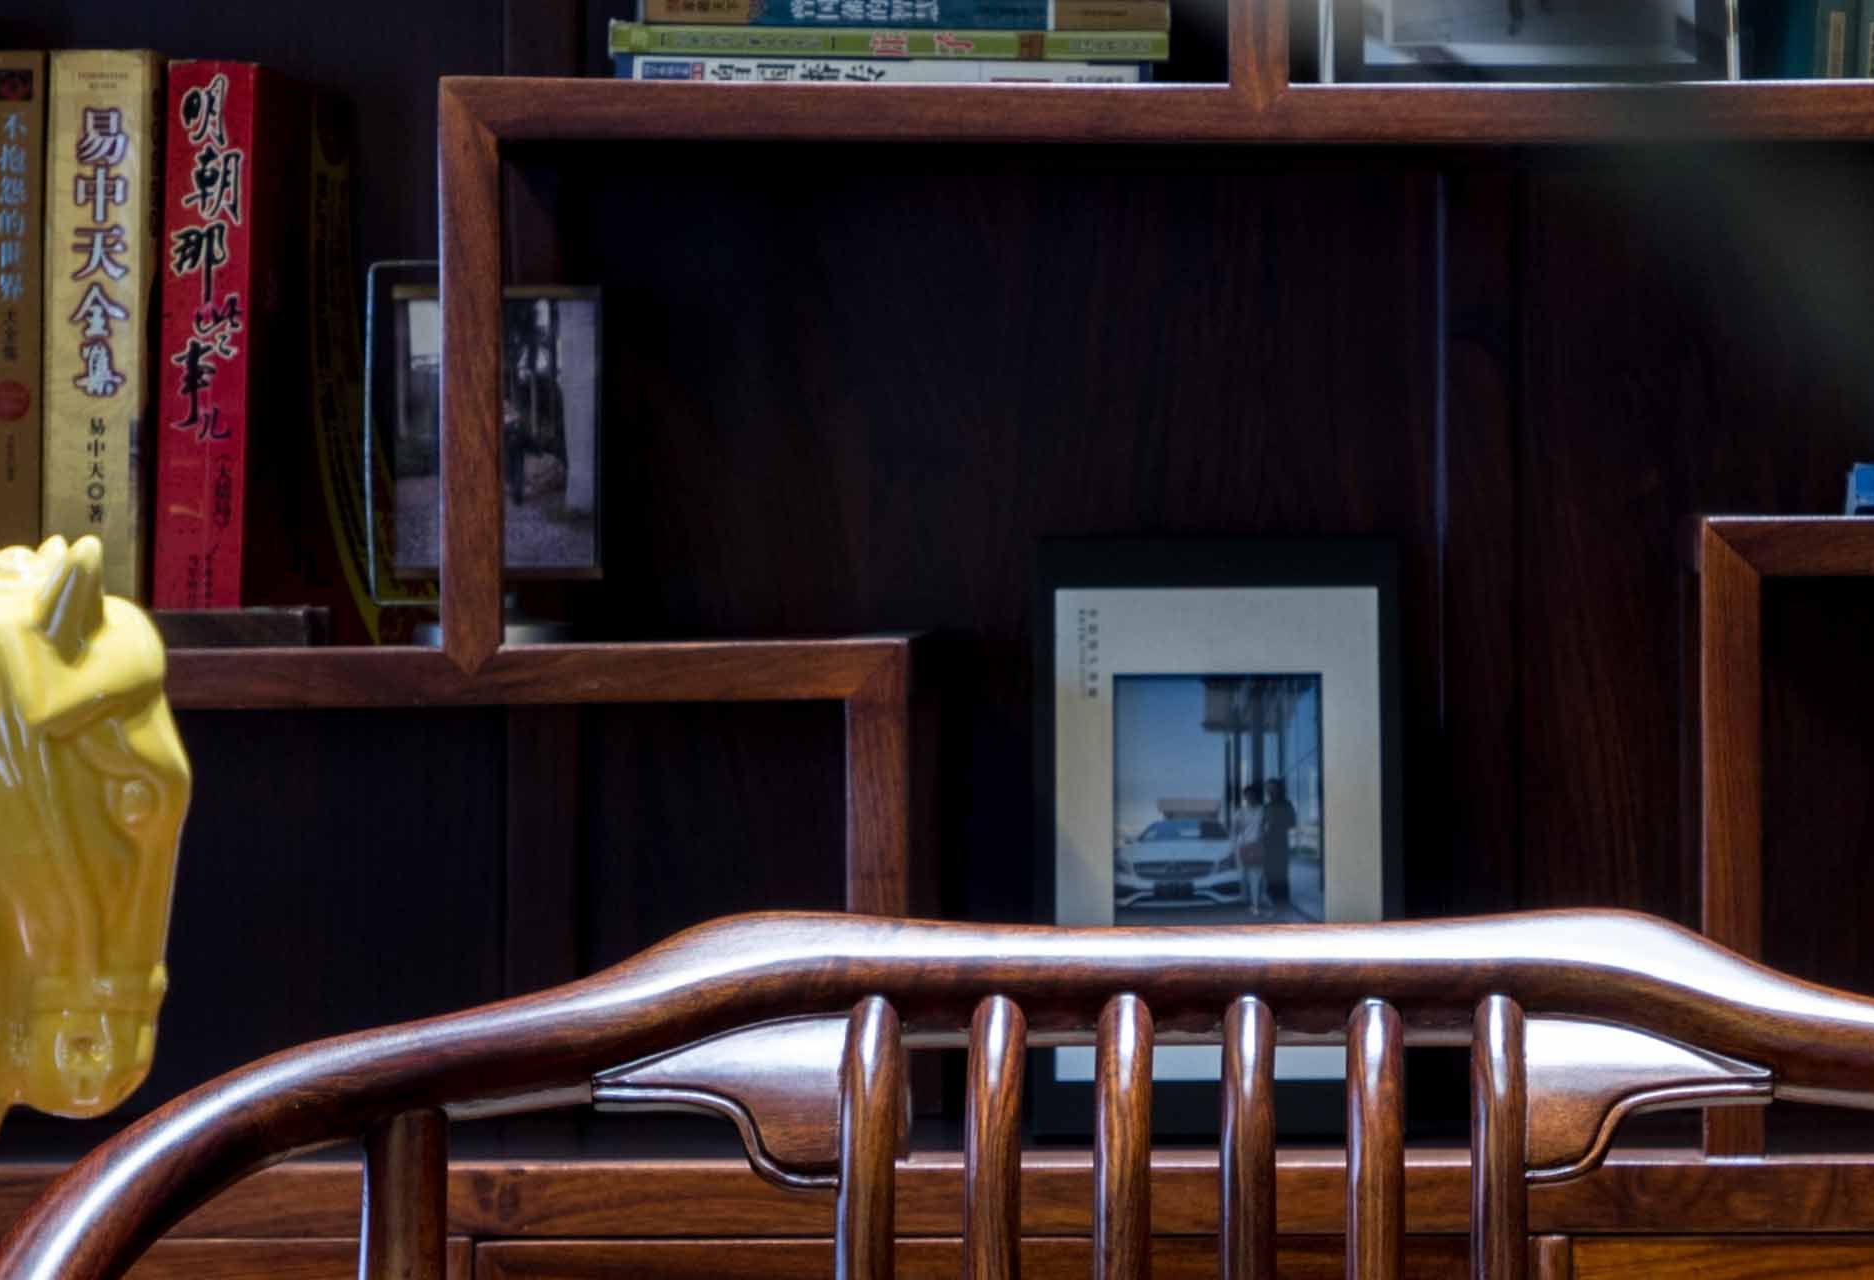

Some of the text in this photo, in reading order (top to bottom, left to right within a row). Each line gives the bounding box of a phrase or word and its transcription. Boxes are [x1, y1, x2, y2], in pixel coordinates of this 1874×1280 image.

[869, 30, 974, 58] 庄子
[72, 107, 130, 397] 易中天全集
[168, 73, 245, 441] 明朝那些事儿
[86, 417, 106, 481] 易中天
